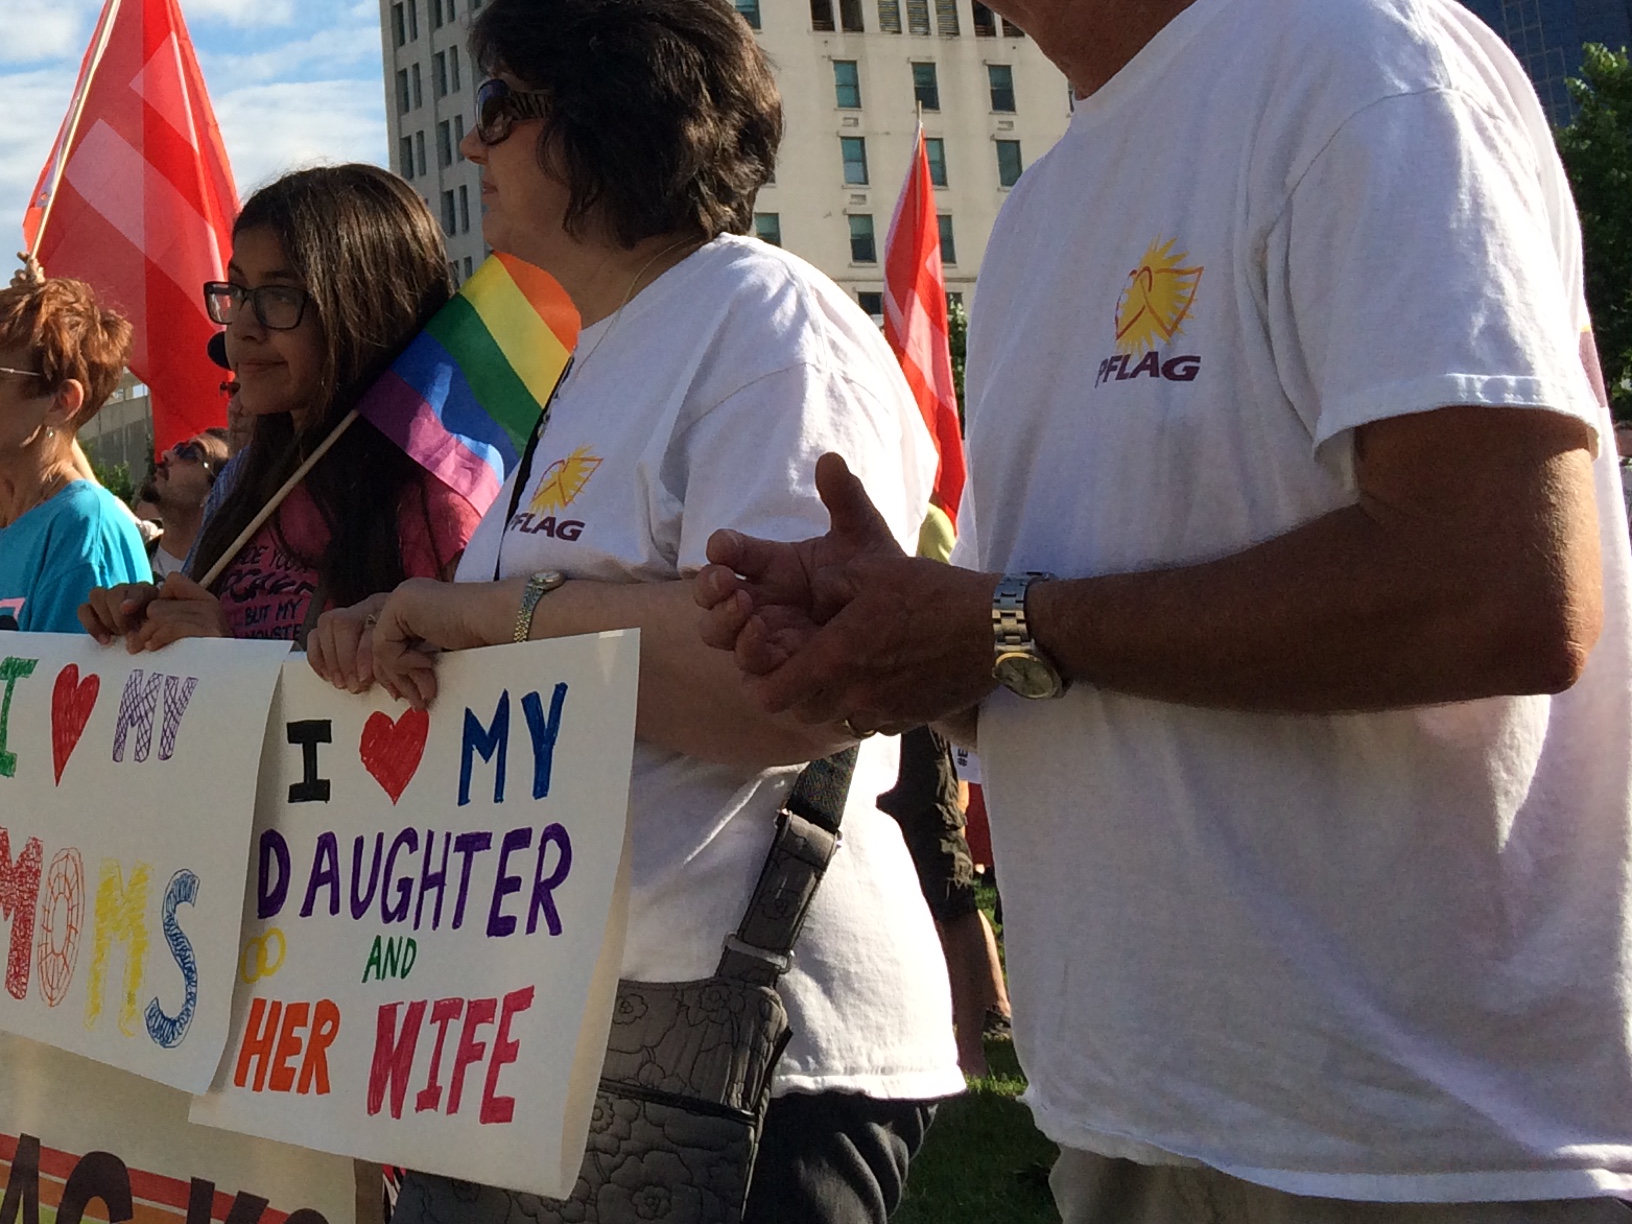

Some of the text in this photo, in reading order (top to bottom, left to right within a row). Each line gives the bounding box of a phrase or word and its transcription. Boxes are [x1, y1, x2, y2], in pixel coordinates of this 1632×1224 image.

[1094, 351, 1201, 389] PFLAG
[509, 512, 586, 542] FLAG
[245, 605, 271, 626] BUT
[276, 598, 303, 621] MY
[112, 669, 199, 763] MY
[286, 682, 568, 807] I MY
[257, 822, 572, 937] DAUGHTER
[362, 935, 417, 983] AND
[234, 985, 535, 1124] HER WIFE
